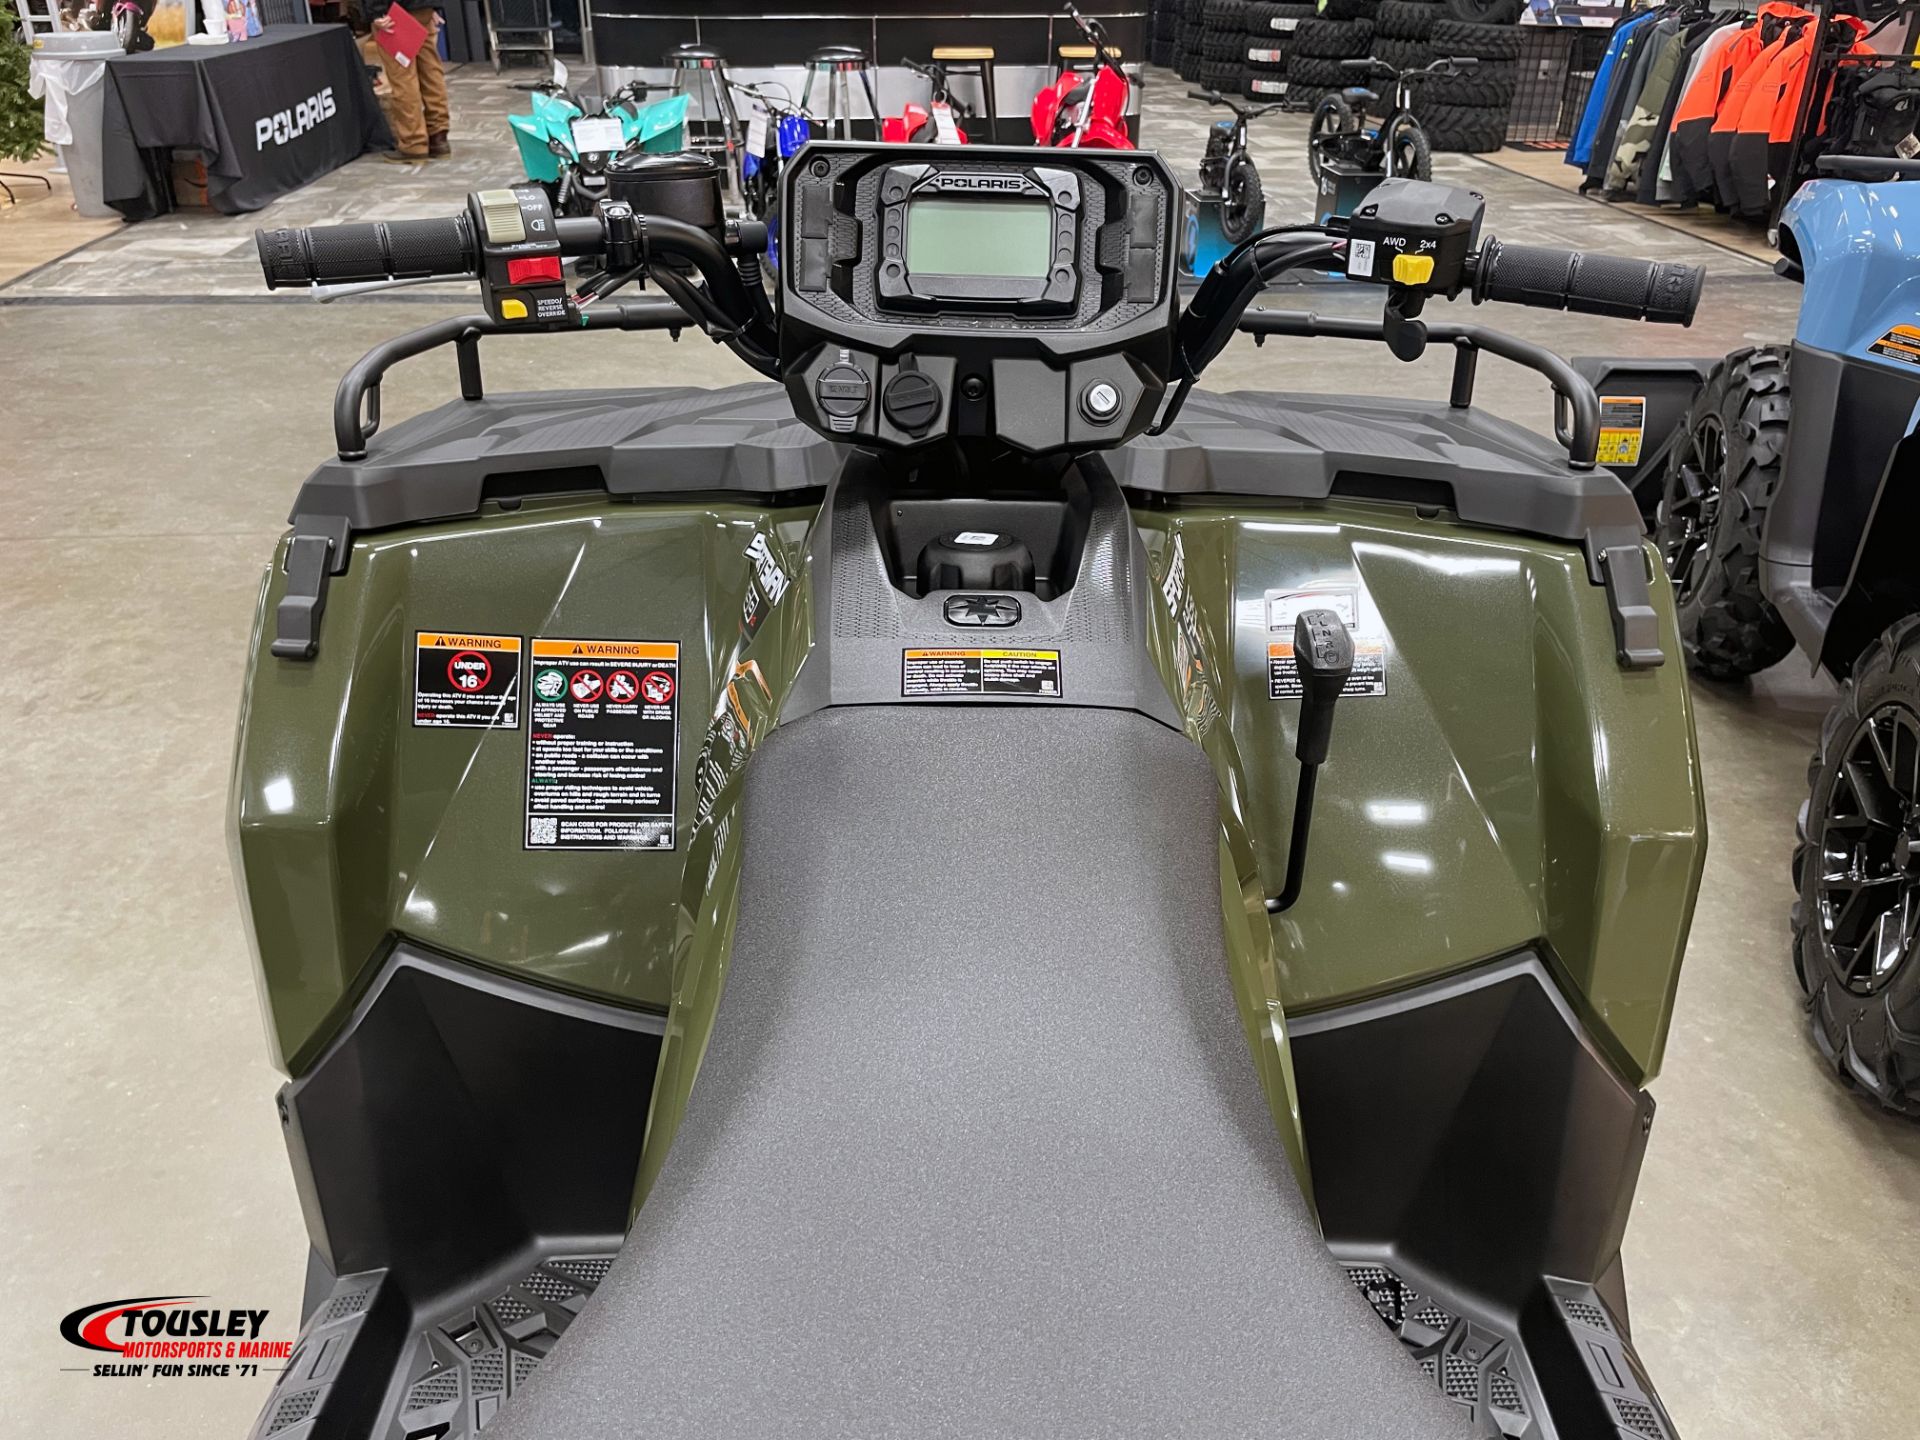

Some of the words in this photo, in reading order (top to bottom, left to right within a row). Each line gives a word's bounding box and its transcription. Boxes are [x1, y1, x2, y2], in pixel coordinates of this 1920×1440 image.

[256, 86, 336, 151] POLARIS
[941, 178, 1020, 189] POLARIS
[1383, 237, 1406, 247] AWD
[1420, 240, 1437, 249] 2x4
[448, 638, 502, 648] WARNING
[587, 645, 640, 655] WARNING
[454, 661, 486, 670] UNDER
[459, 674, 478, 688] 16
